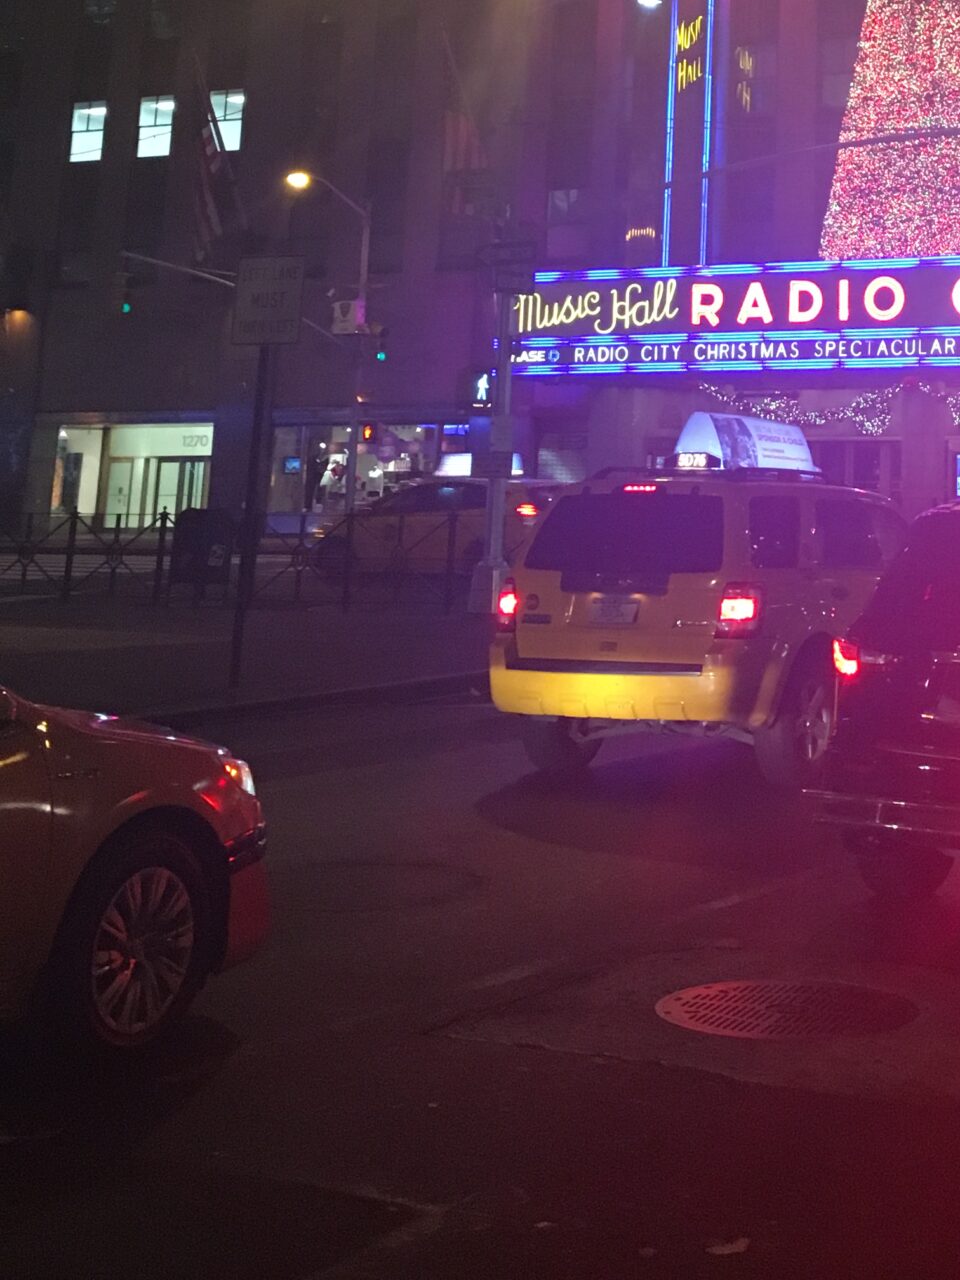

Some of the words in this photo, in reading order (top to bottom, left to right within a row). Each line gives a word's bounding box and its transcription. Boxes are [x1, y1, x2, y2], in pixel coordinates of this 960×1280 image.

[251, 291, 287, 308] MUST
[512, 290, 600, 333] Music
[594, 278, 679, 335] Hall
[689, 275, 906, 327] RADIO
[573, 345, 629, 362] RADIO
[640, 344, 681, 362] CITY
[694, 342, 799, 360] CHRISTMAS
[814, 338, 956, 358] SPECTACULAR
[182, 434, 208, 447] 1270
